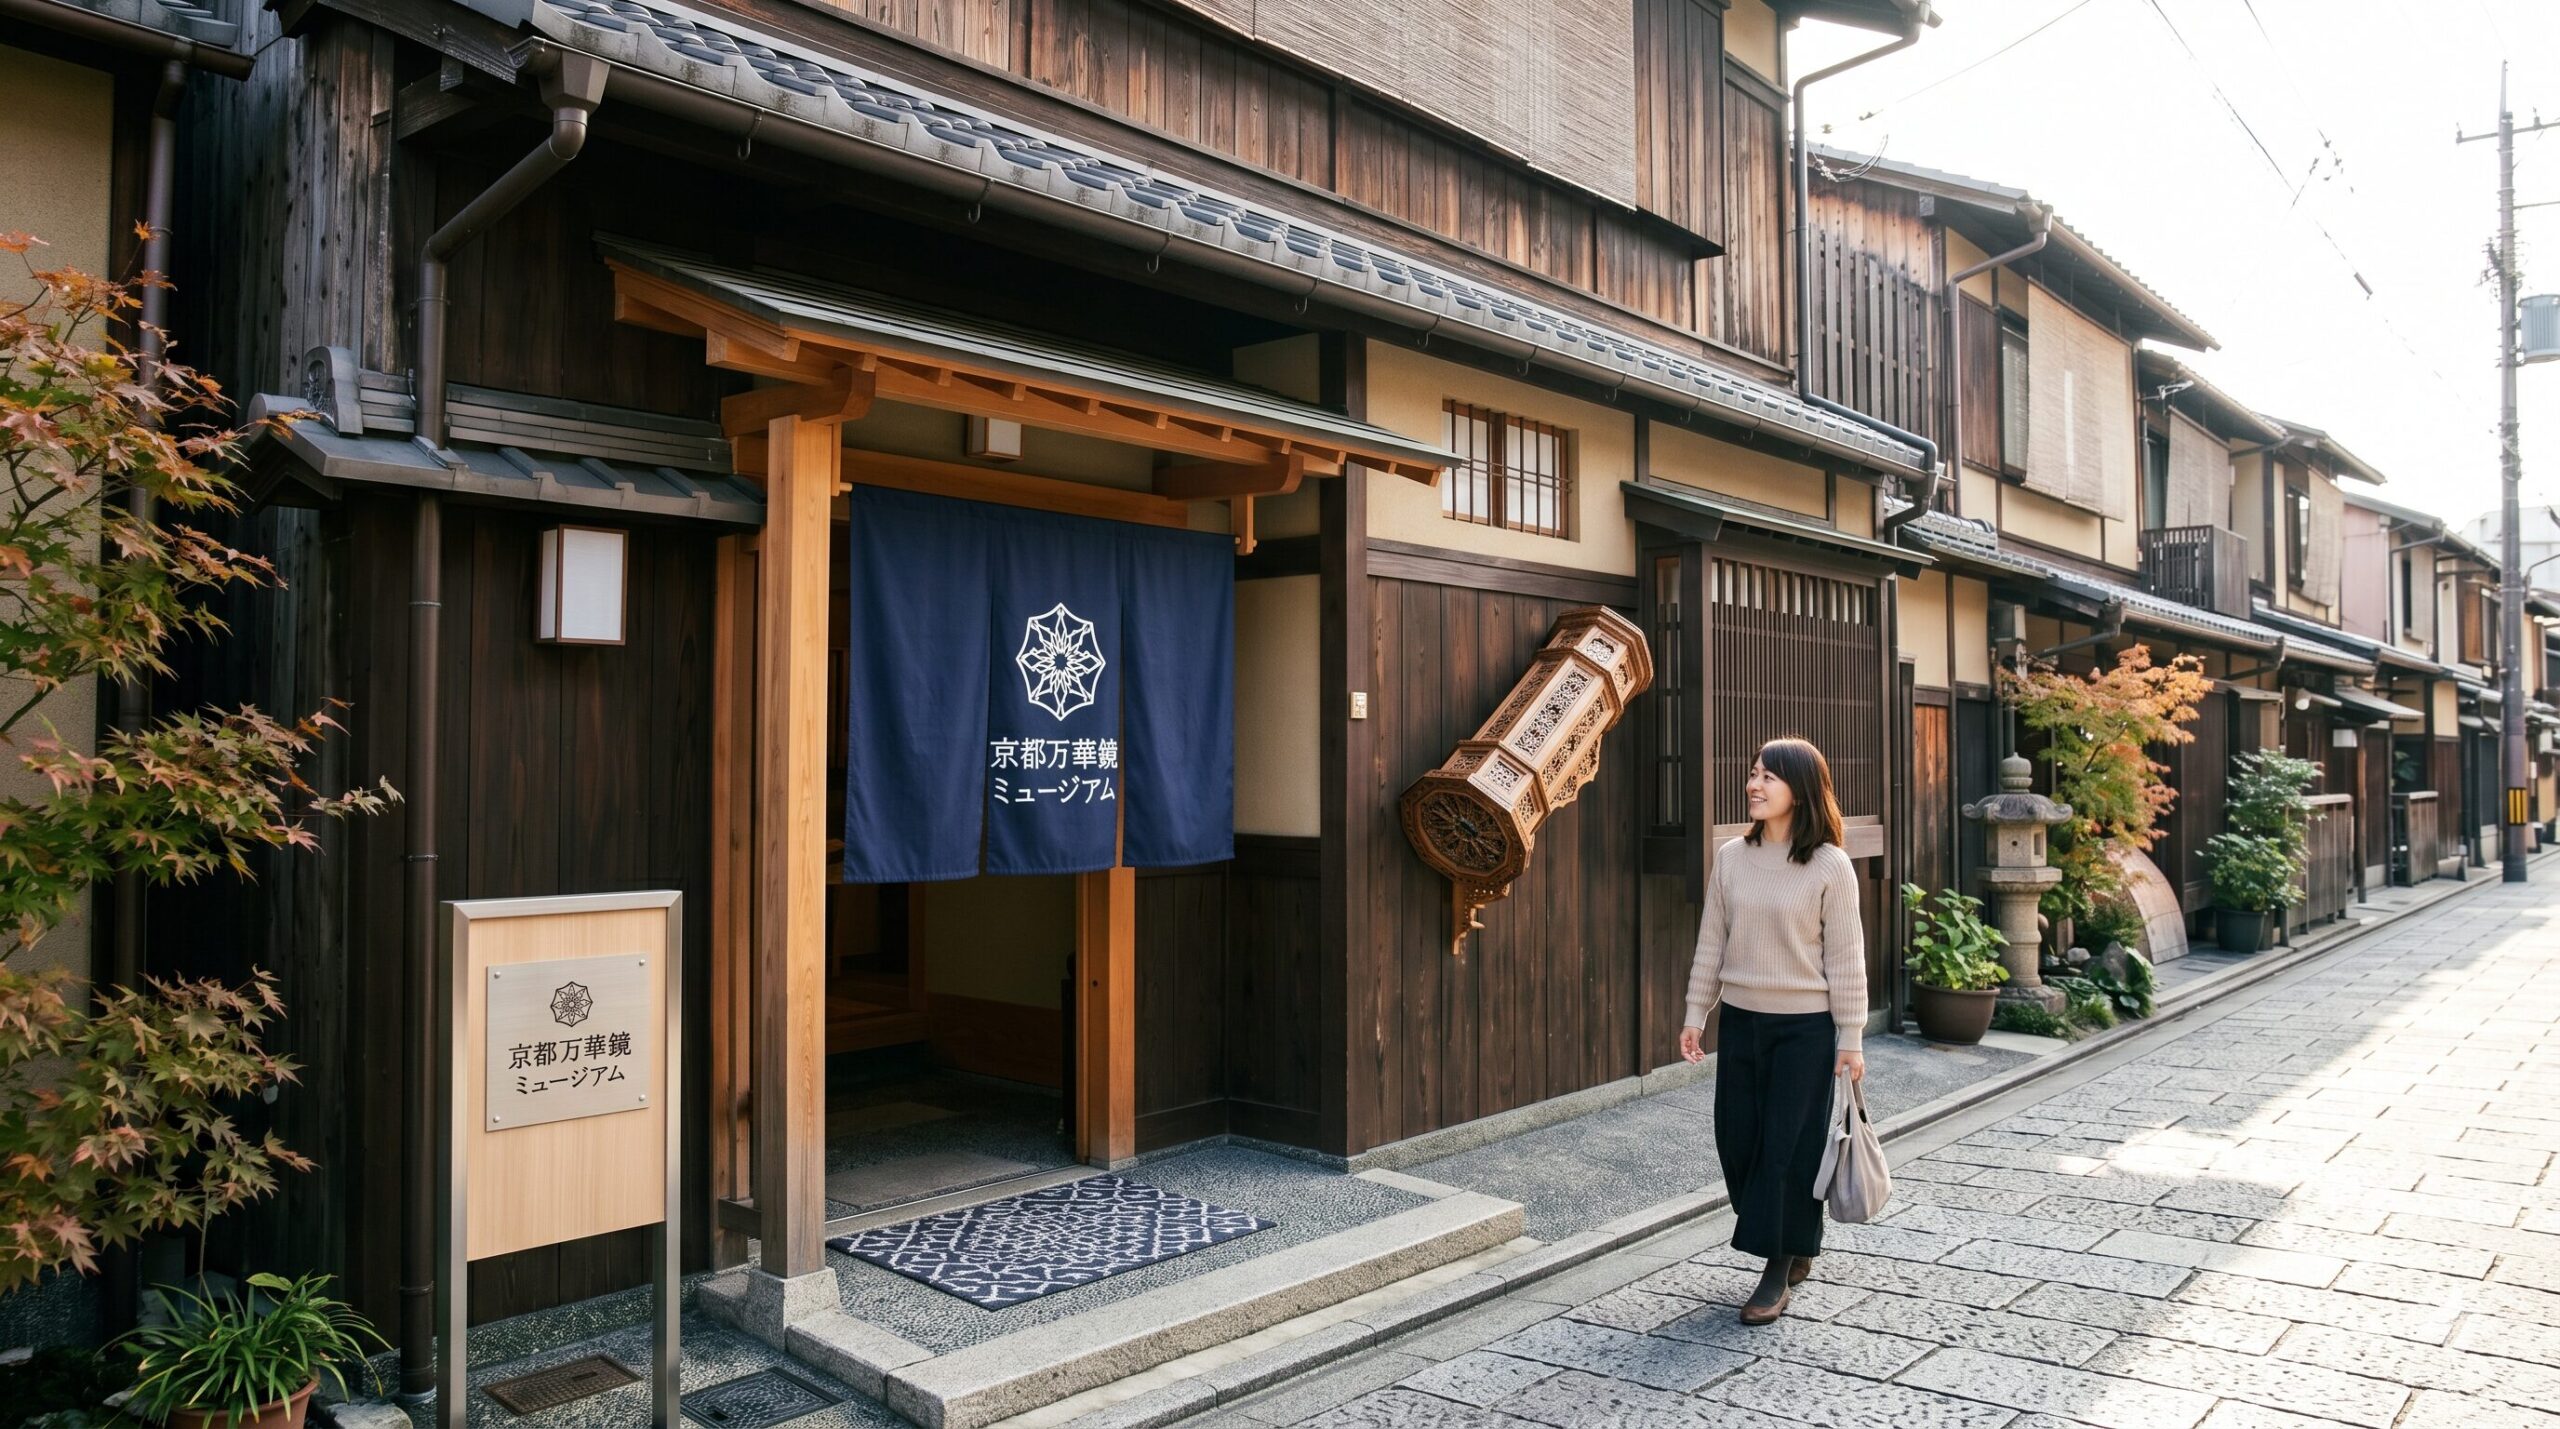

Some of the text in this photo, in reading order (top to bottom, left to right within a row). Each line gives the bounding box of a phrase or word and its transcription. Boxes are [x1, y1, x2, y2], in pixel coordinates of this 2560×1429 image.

[990, 737, 1118, 770] 京都万華鏡
[994, 775, 1116, 804] ミュージアム
[508, 1031, 632, 1069] 京都万華鏡
[516, 1065, 625, 1095] ミュージアム
